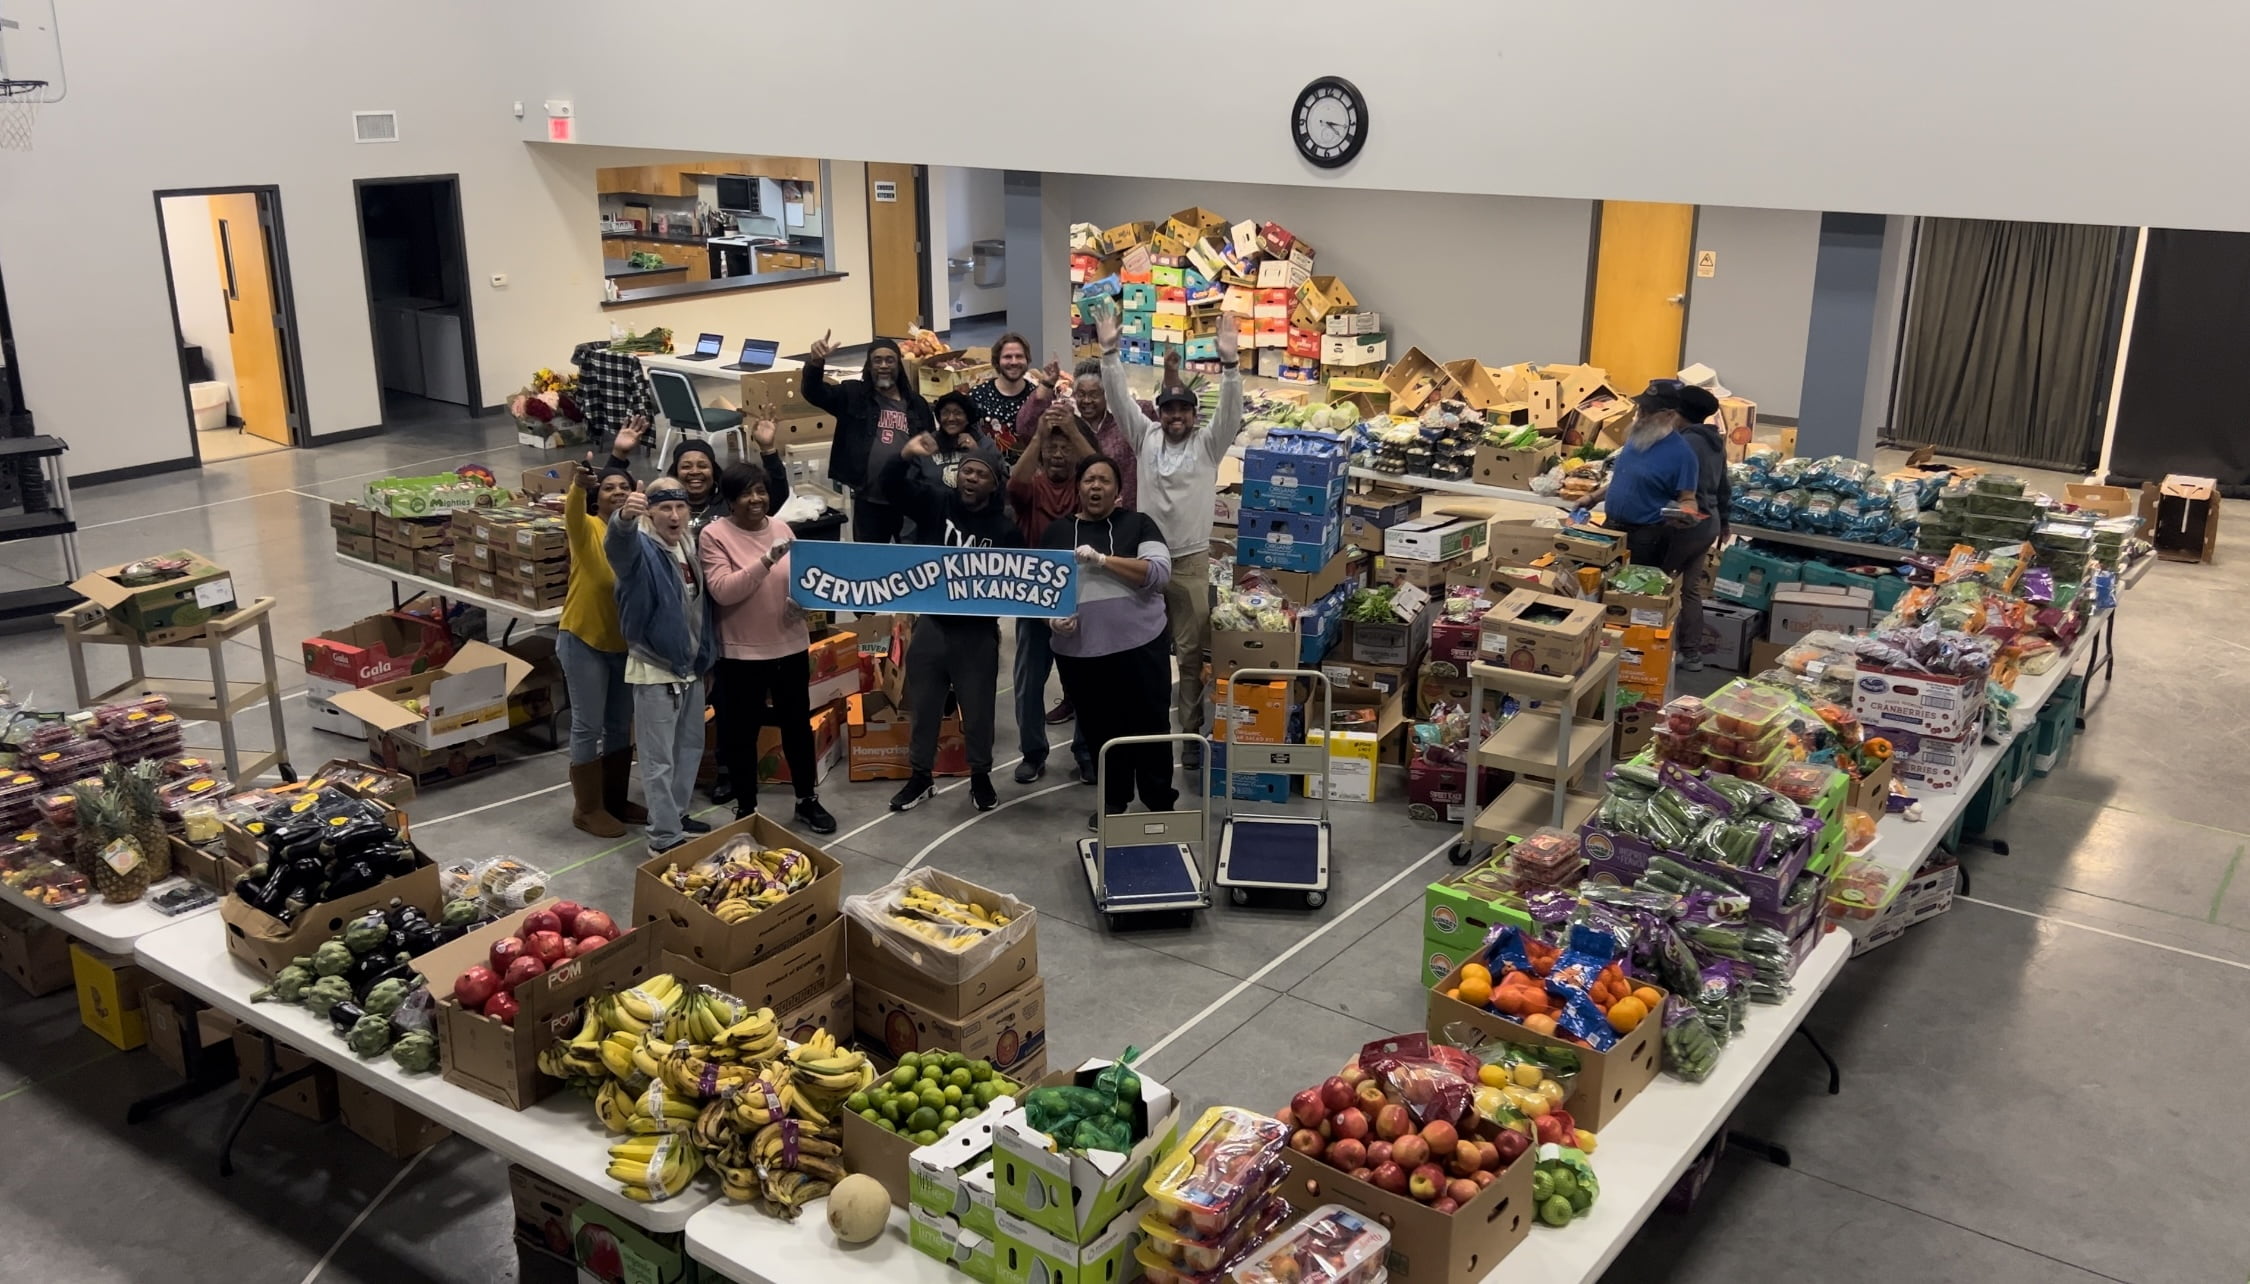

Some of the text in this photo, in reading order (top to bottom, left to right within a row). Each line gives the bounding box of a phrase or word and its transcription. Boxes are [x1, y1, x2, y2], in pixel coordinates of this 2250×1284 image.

[881, 429, 894, 445] S
[800, 552, 1070, 606] SERVING UP KINDNESS
[948, 579, 1061, 609] IN KANSAS!
[332, 653, 349, 664] Gala
[360, 661, 391, 679] Gala
[1870, 702, 1937, 719] CRANBERRIES
